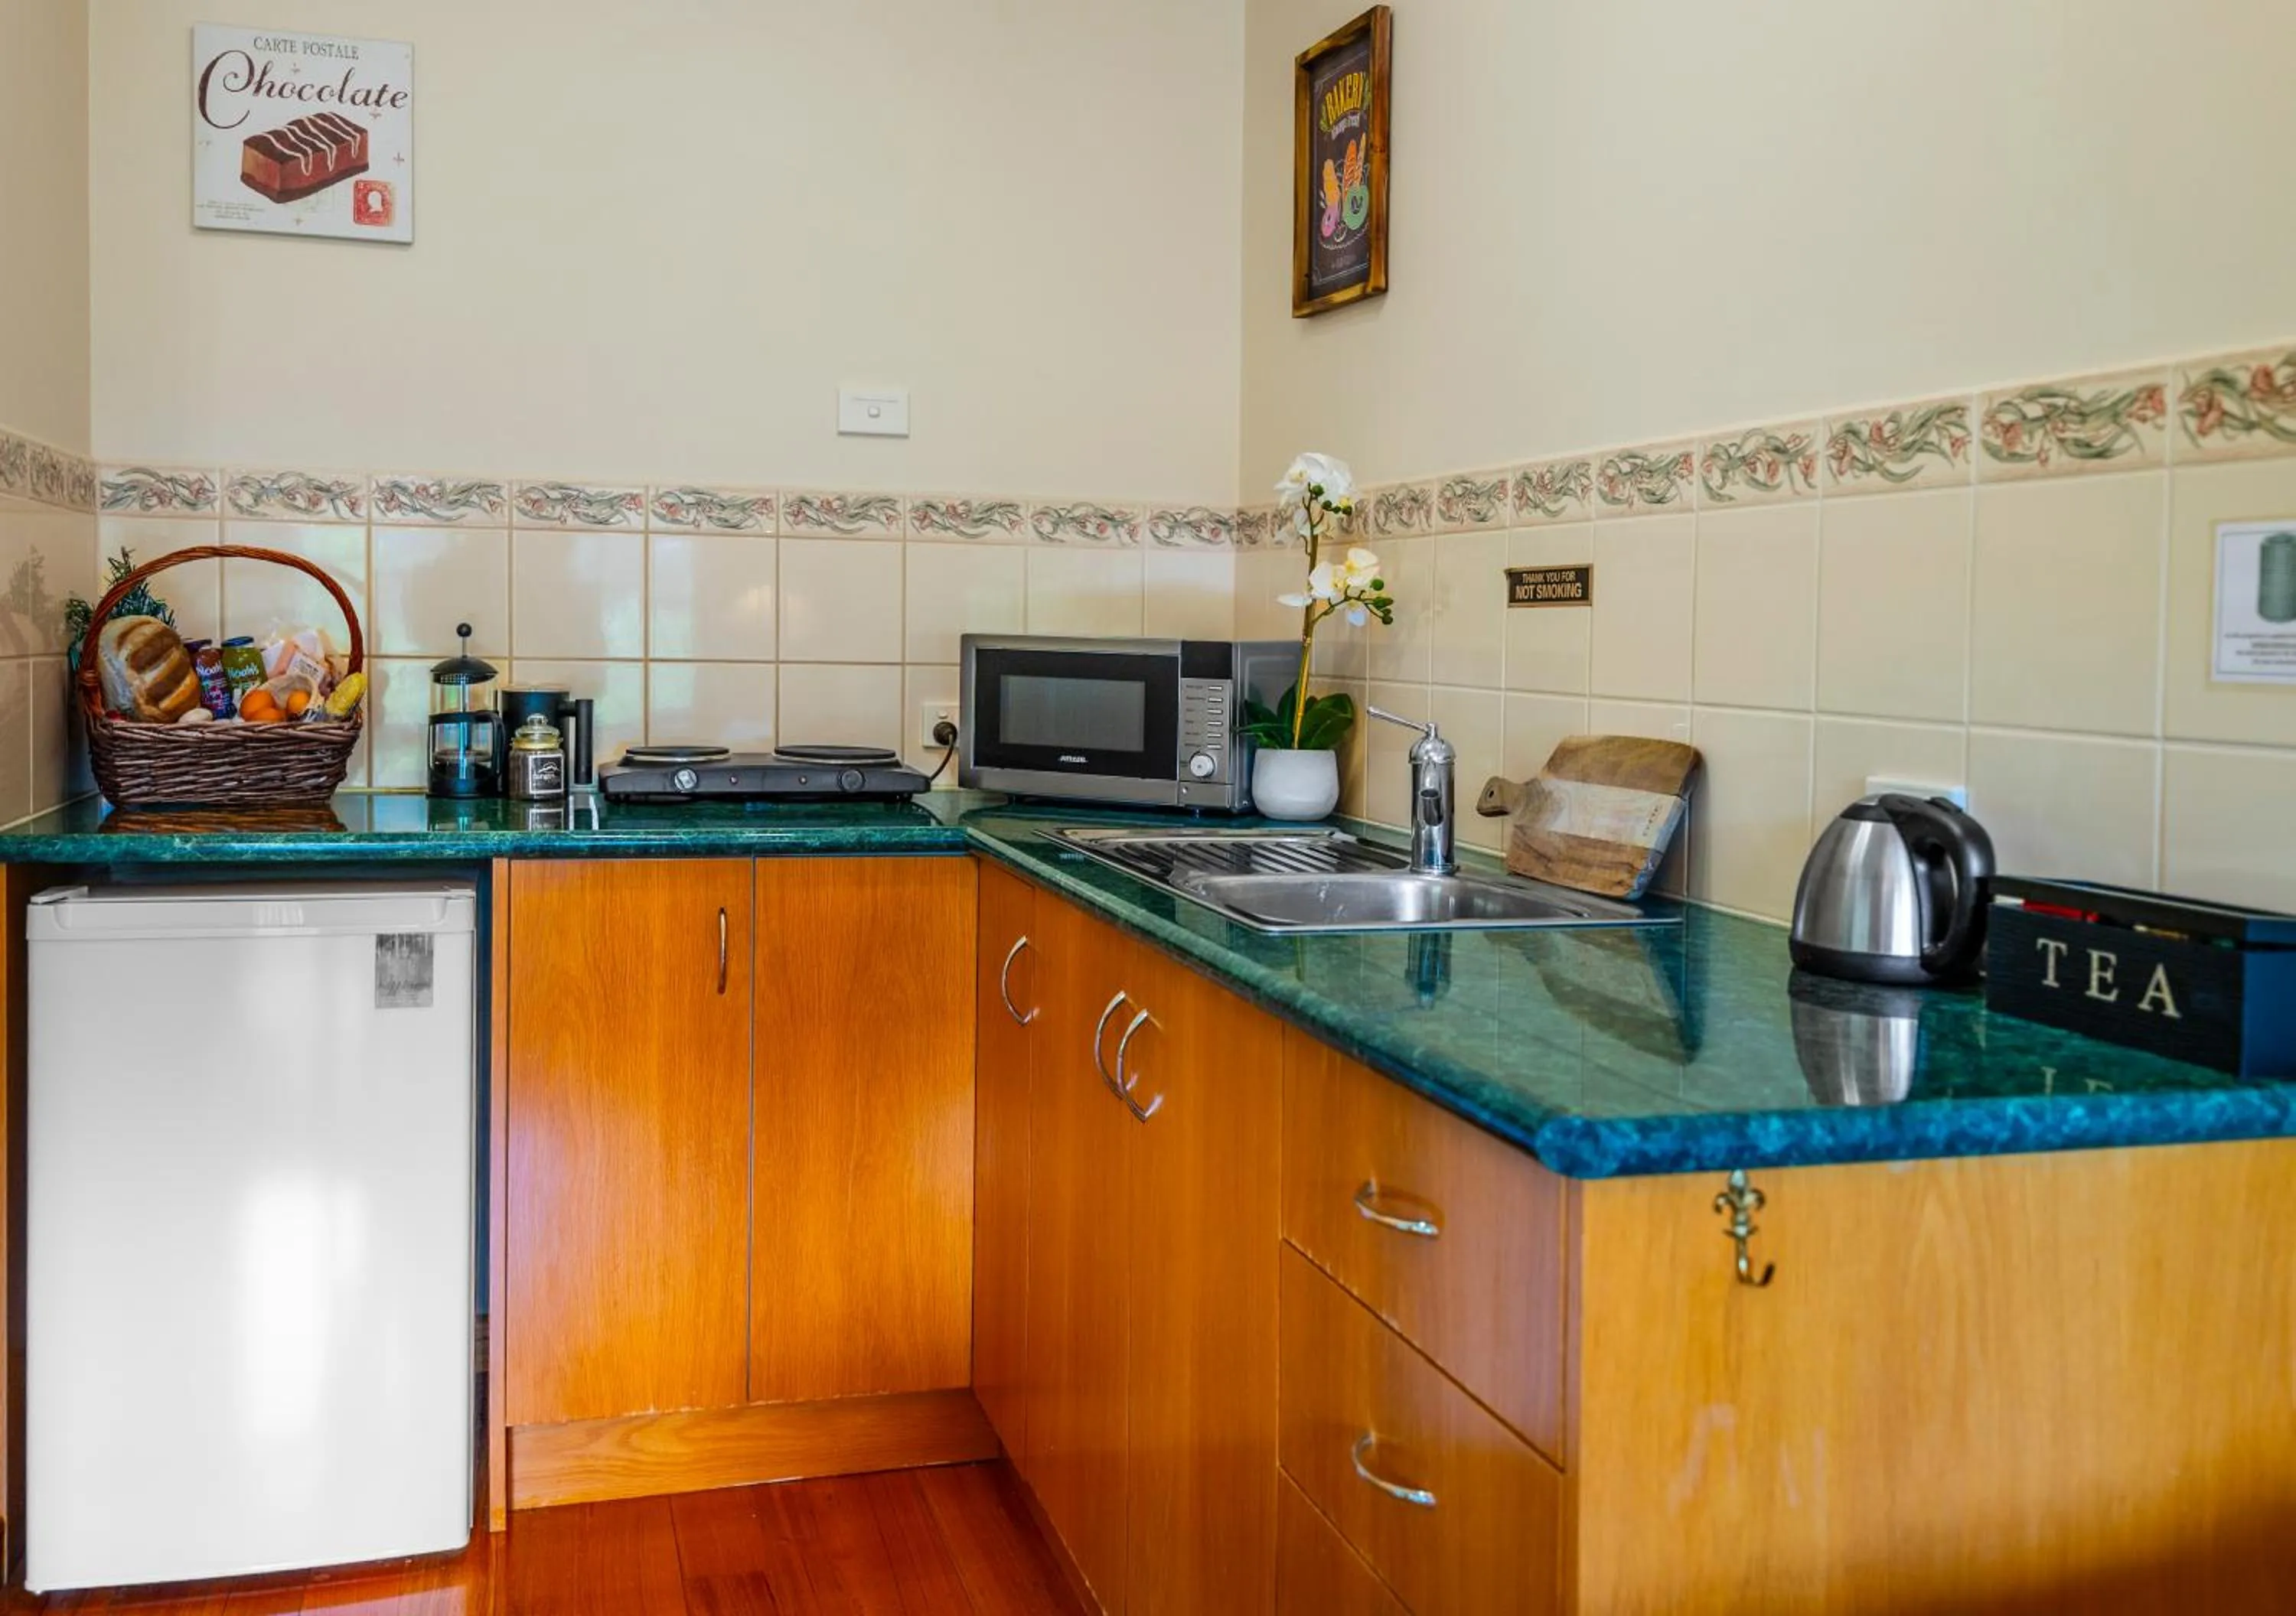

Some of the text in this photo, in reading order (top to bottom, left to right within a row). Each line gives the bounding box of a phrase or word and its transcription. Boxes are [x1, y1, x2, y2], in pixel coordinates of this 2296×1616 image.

[253, 36, 359, 60] CARTE POSTALE
[198, 50, 408, 129] Chocolate
[1326, 70, 1362, 125] BAKERY
[1515, 582, 1582, 600] NOT SMOKING
[1522, 570, 1576, 583] THANK YOU FOR
[2037, 938, 2182, 1018] TEA
